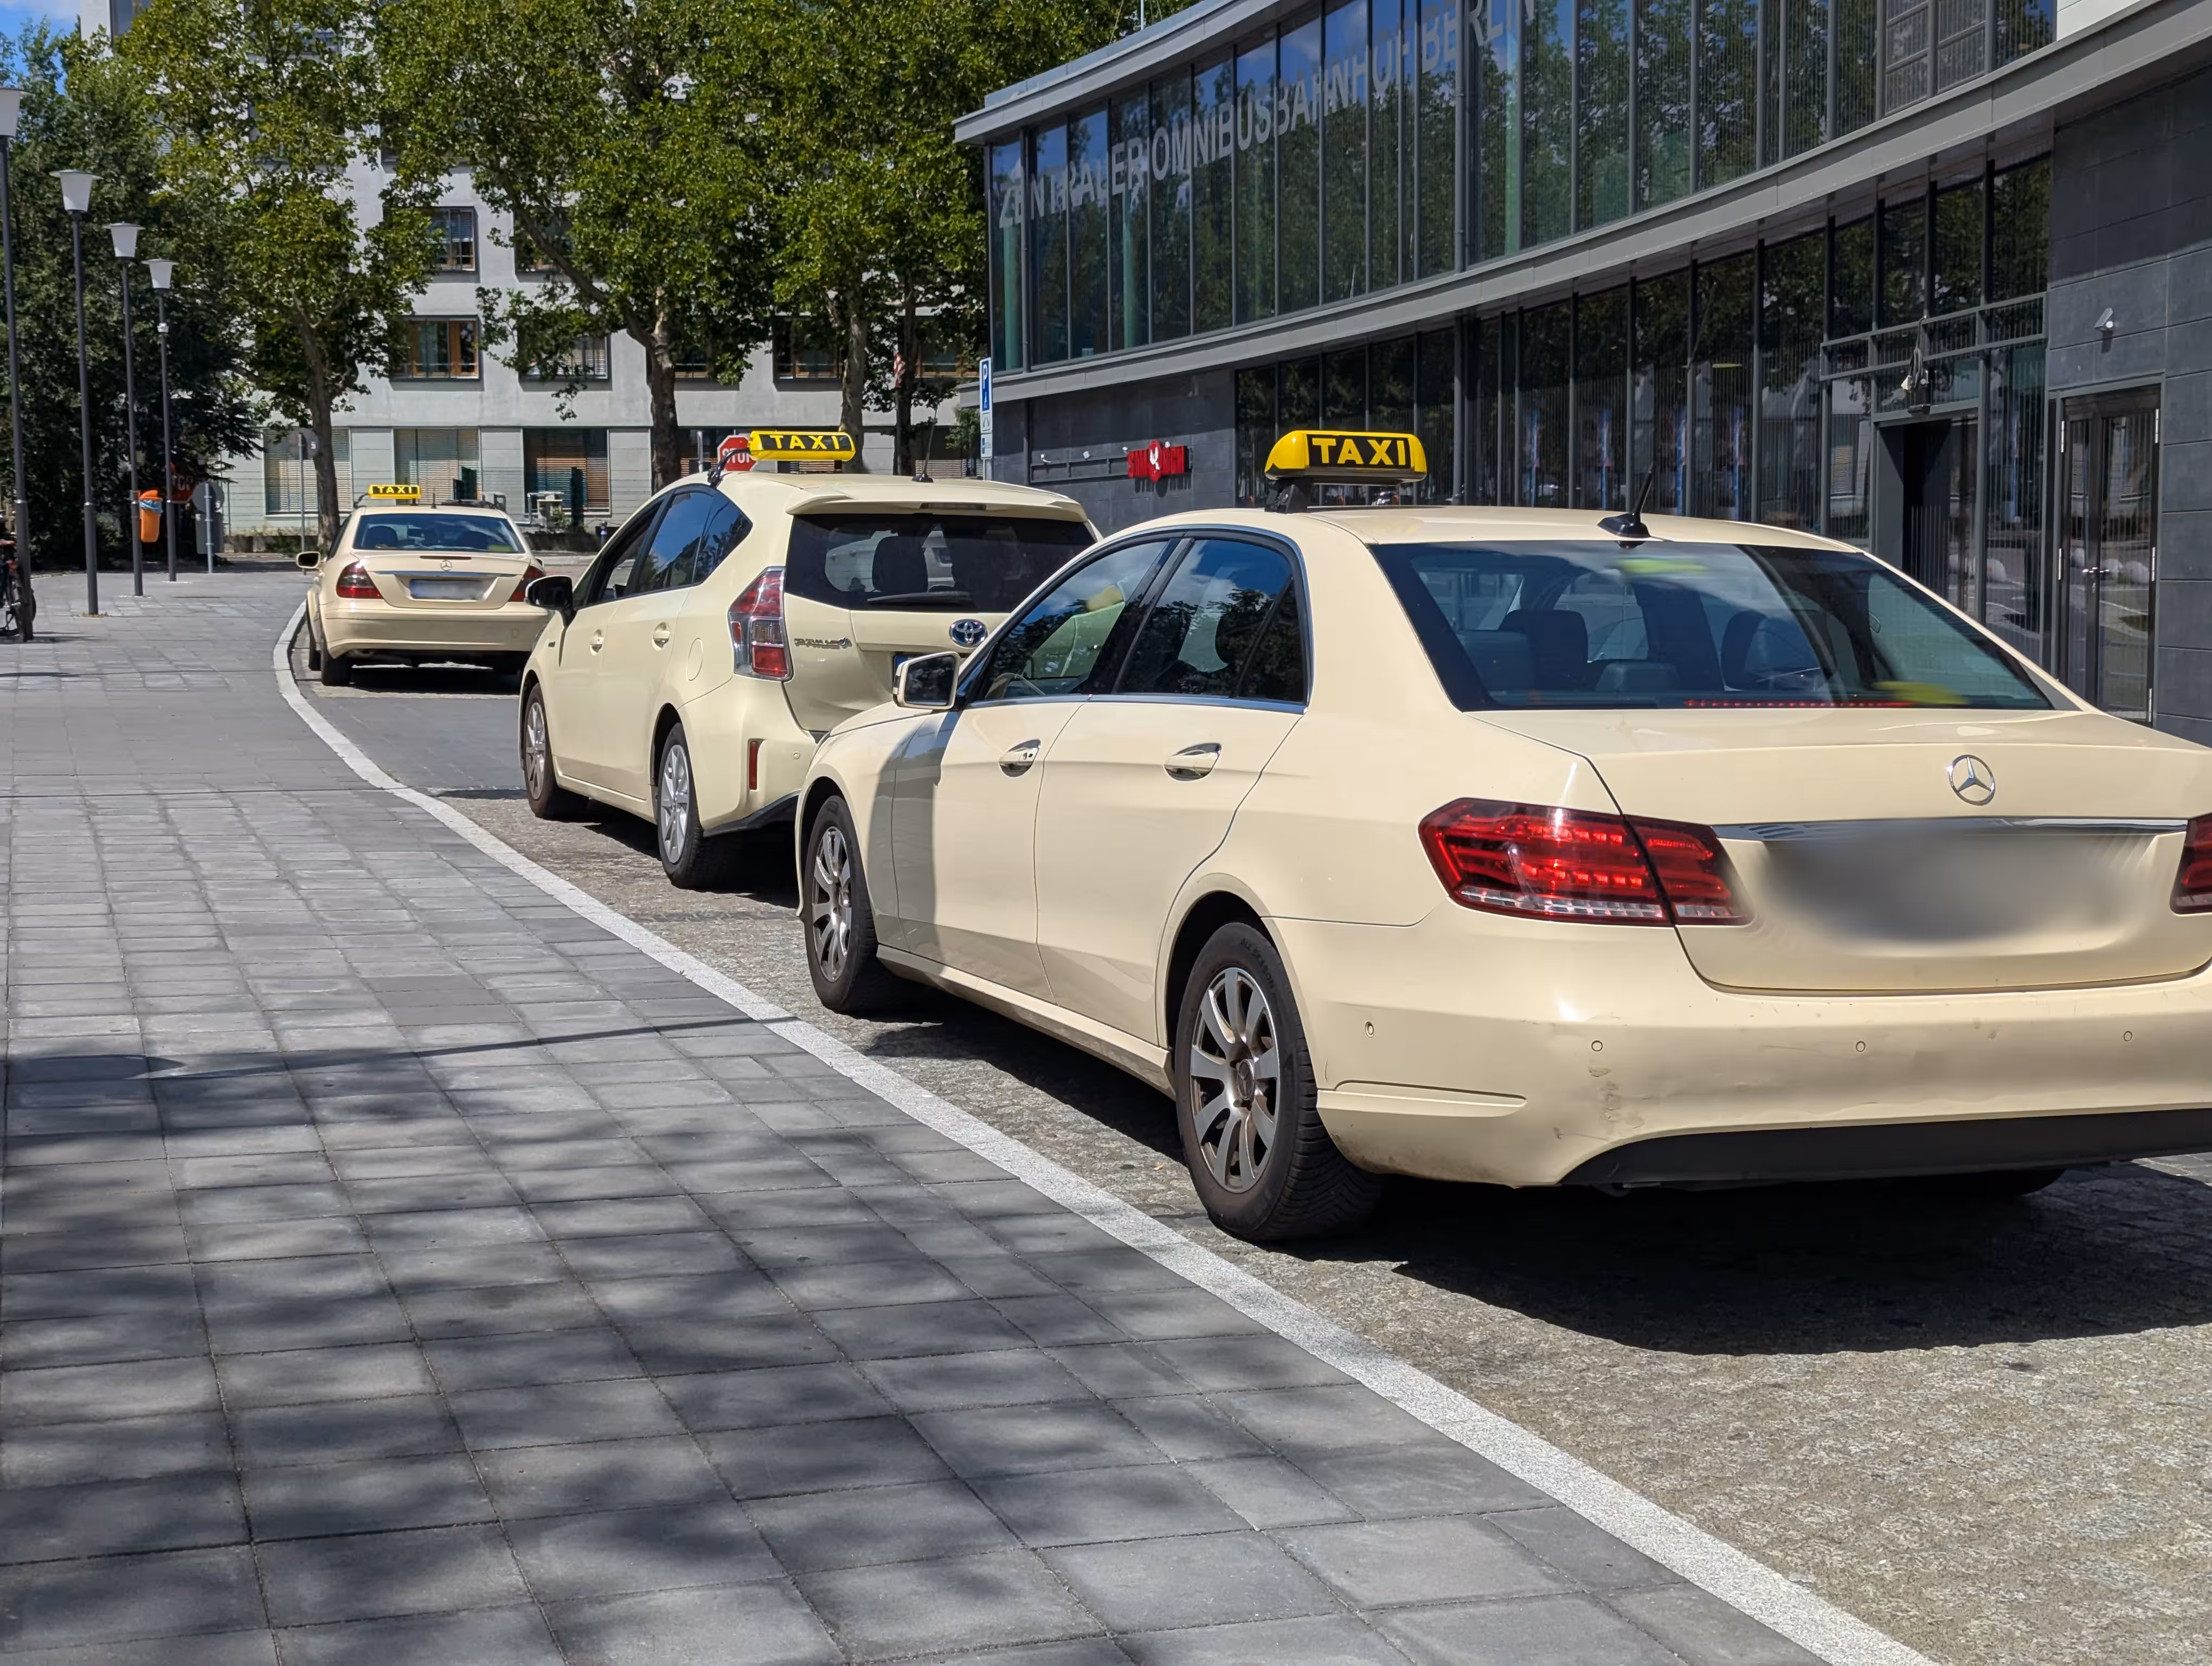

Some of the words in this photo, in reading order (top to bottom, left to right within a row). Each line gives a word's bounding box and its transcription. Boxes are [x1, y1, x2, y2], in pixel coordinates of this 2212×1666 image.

[999, 137, 1144, 228] ZENTRALER
[1151, 20, 1412, 181] OMNIBUSBAHNHOF
[983, 364, 987, 389] P
[769, 435, 840, 449] TAXI
[1311, 438, 1406, 465] TAXI
